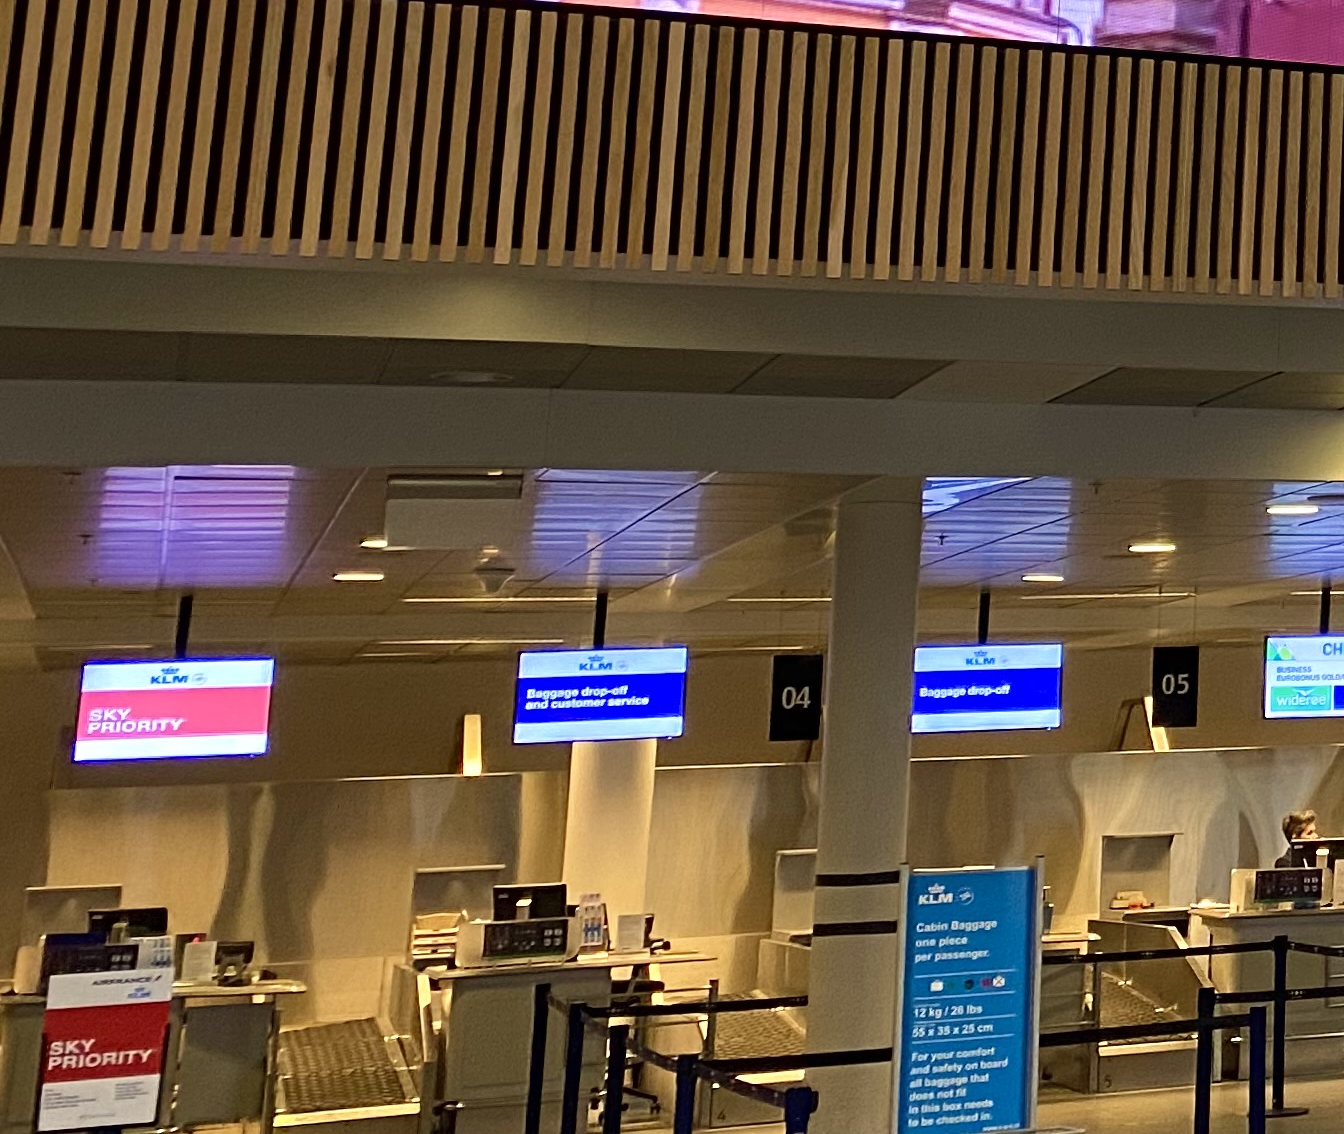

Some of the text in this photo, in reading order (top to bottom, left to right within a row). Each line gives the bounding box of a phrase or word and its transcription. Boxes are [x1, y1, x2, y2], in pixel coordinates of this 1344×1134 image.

[579, 662, 612, 671] KLM
[150, 675, 188, 684] KLM
[1162, 673, 1190, 695] 05
[526, 685, 628, 700] Baggage drop-off
[781, 686, 811, 709] 04
[525, 696, 649, 710] and customer service
[88, 707, 131, 722] SKY
[87, 718, 184, 734] PRIORITY
[918, 893, 954, 905] KLM
[916, 920, 997, 933] Cabin Baggage
[915, 936, 968, 948] one piece
[914, 953, 932, 964] per
[914, 1007, 926, 1018] 12
[928, 1007, 942, 1019] kg
[966, 1004, 983, 1014] lbs
[49, 1038, 95, 1055] SKY
[48, 1049, 153, 1071] PRIORITY
[911, 1047, 995, 1063] For your comfort
[910, 1057, 1008, 1075] and safety board
